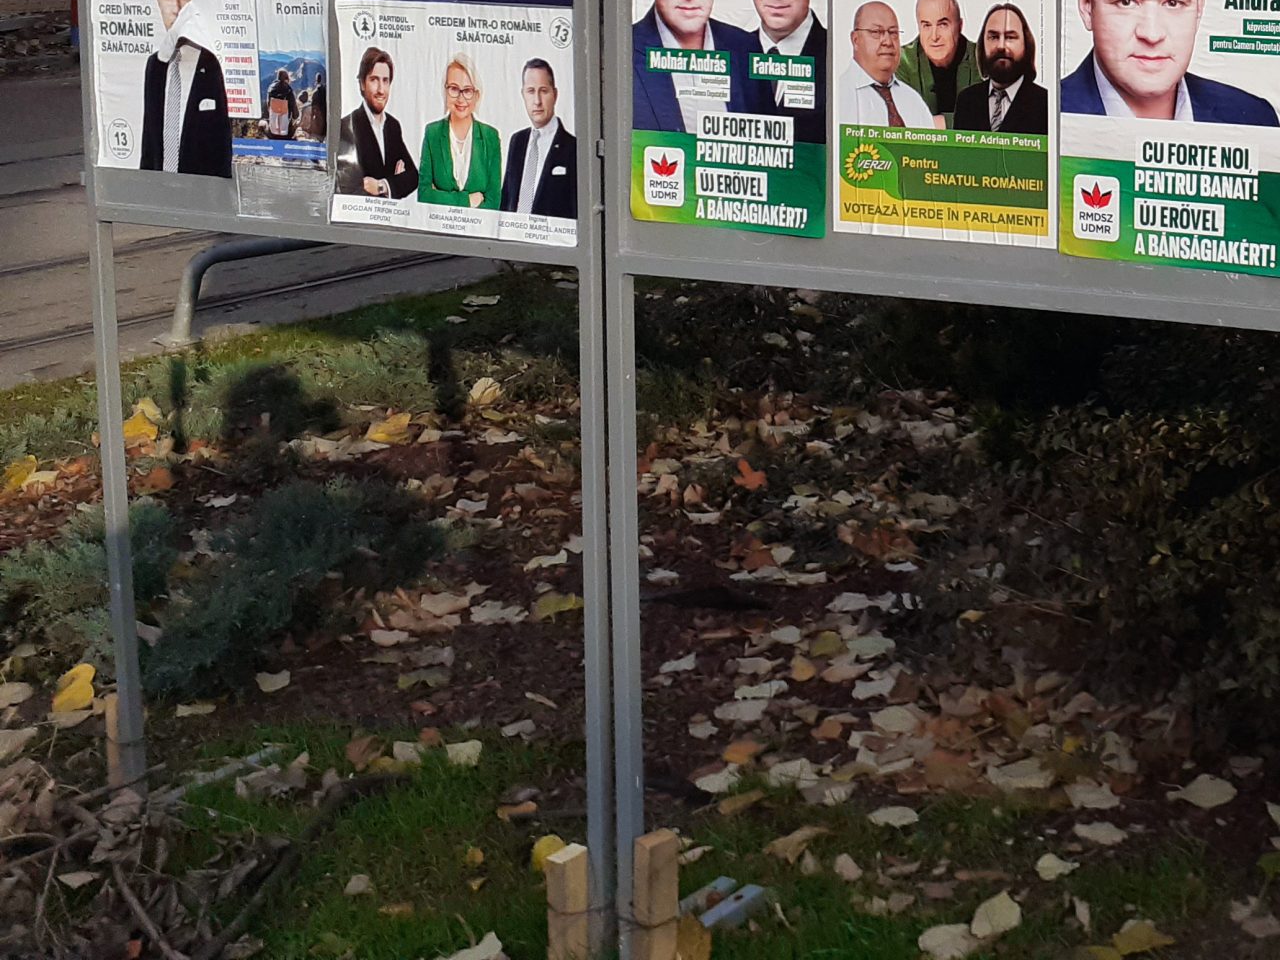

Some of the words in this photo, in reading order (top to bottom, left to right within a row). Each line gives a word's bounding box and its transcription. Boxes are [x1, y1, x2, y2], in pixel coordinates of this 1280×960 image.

[99, 4, 122, 15] CRED
[123, 2, 151, 15] ÎNTR-O
[100, 19, 154, 37] ROMÂNIE
[554, 24, 569, 42] 13
[650, 51, 688, 70] Molnár
[689, 54, 726, 73] András
[753, 57, 786, 76] Farkas
[788, 59, 812, 78] Imre
[114, 132, 128, 146] 13
[703, 116, 720, 136] CU
[723, 118, 761, 141] FORȚE
[764, 120, 789, 144] NOI,
[696, 141, 746, 165] PENTRU
[748, 147, 794, 169] BANAT!
[902, 156, 939, 169] Pentru
[1142, 141, 1164, 163] CU
[1167, 141, 1217, 171] FORȚE
[1221, 146, 1253, 174] NOI,
[857, 159, 892, 170] VERZII
[650, 180, 679, 190] RMDSZ
[1134, 169, 1197, 196] PENTRU
[1199, 173, 1258, 201] BANAT!
[651, 191, 677, 200] UDMR
[844, 203, 899, 217] VOTEAZĂ
[903, 206, 944, 220] VERDE
[947, 208, 959, 221] ÎN
[964, 211, 1044, 227] PARLAMENT!
[1078, 211, 1114, 223] RMDSZ
[1080, 223, 1112, 235] UDMR
